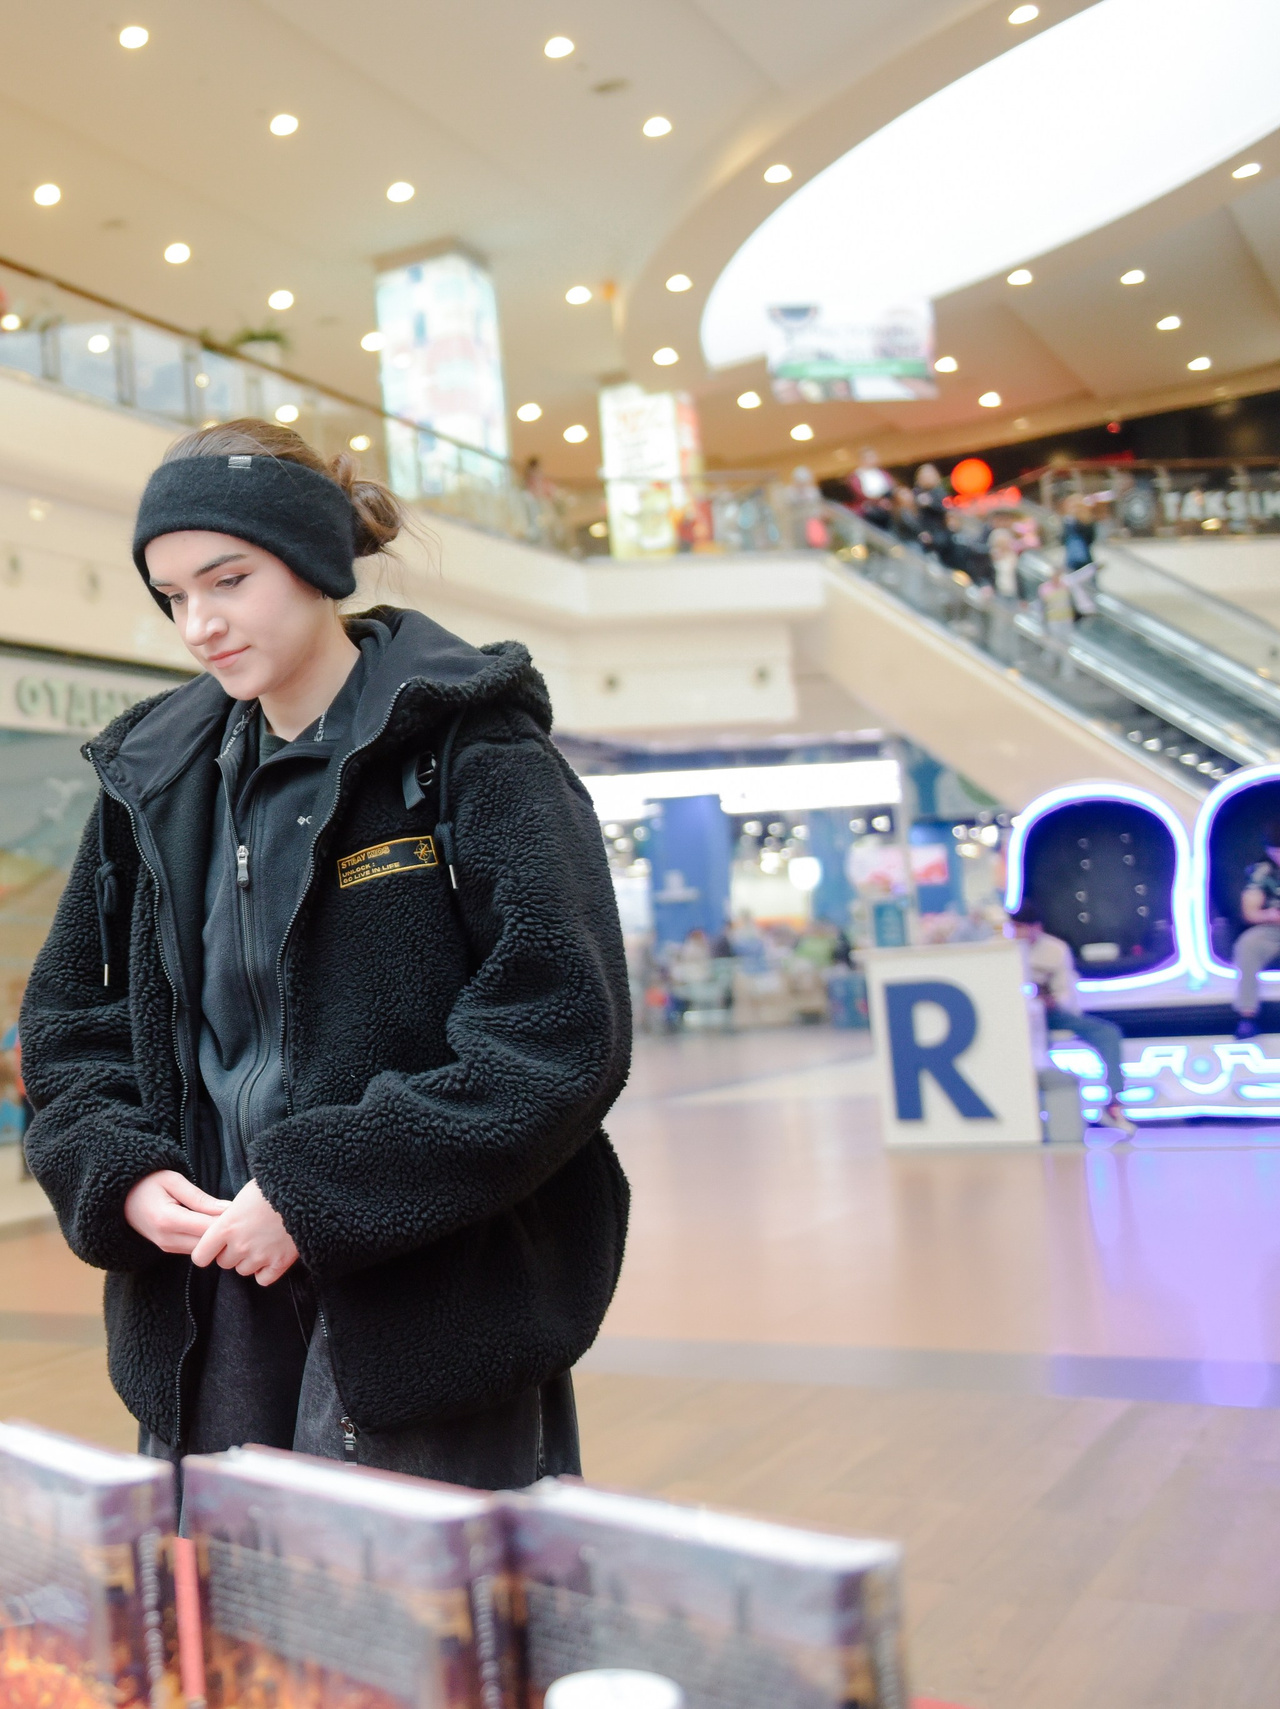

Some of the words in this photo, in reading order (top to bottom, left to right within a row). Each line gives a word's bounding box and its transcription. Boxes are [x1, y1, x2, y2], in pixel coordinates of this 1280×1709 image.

[341, 852, 366, 869] STRAY
[367, 845, 390, 859] KIDS
[354, 870, 370, 879] LIVE
[382, 861, 400, 870] LIFE
[884, 981, 998, 1121] R
